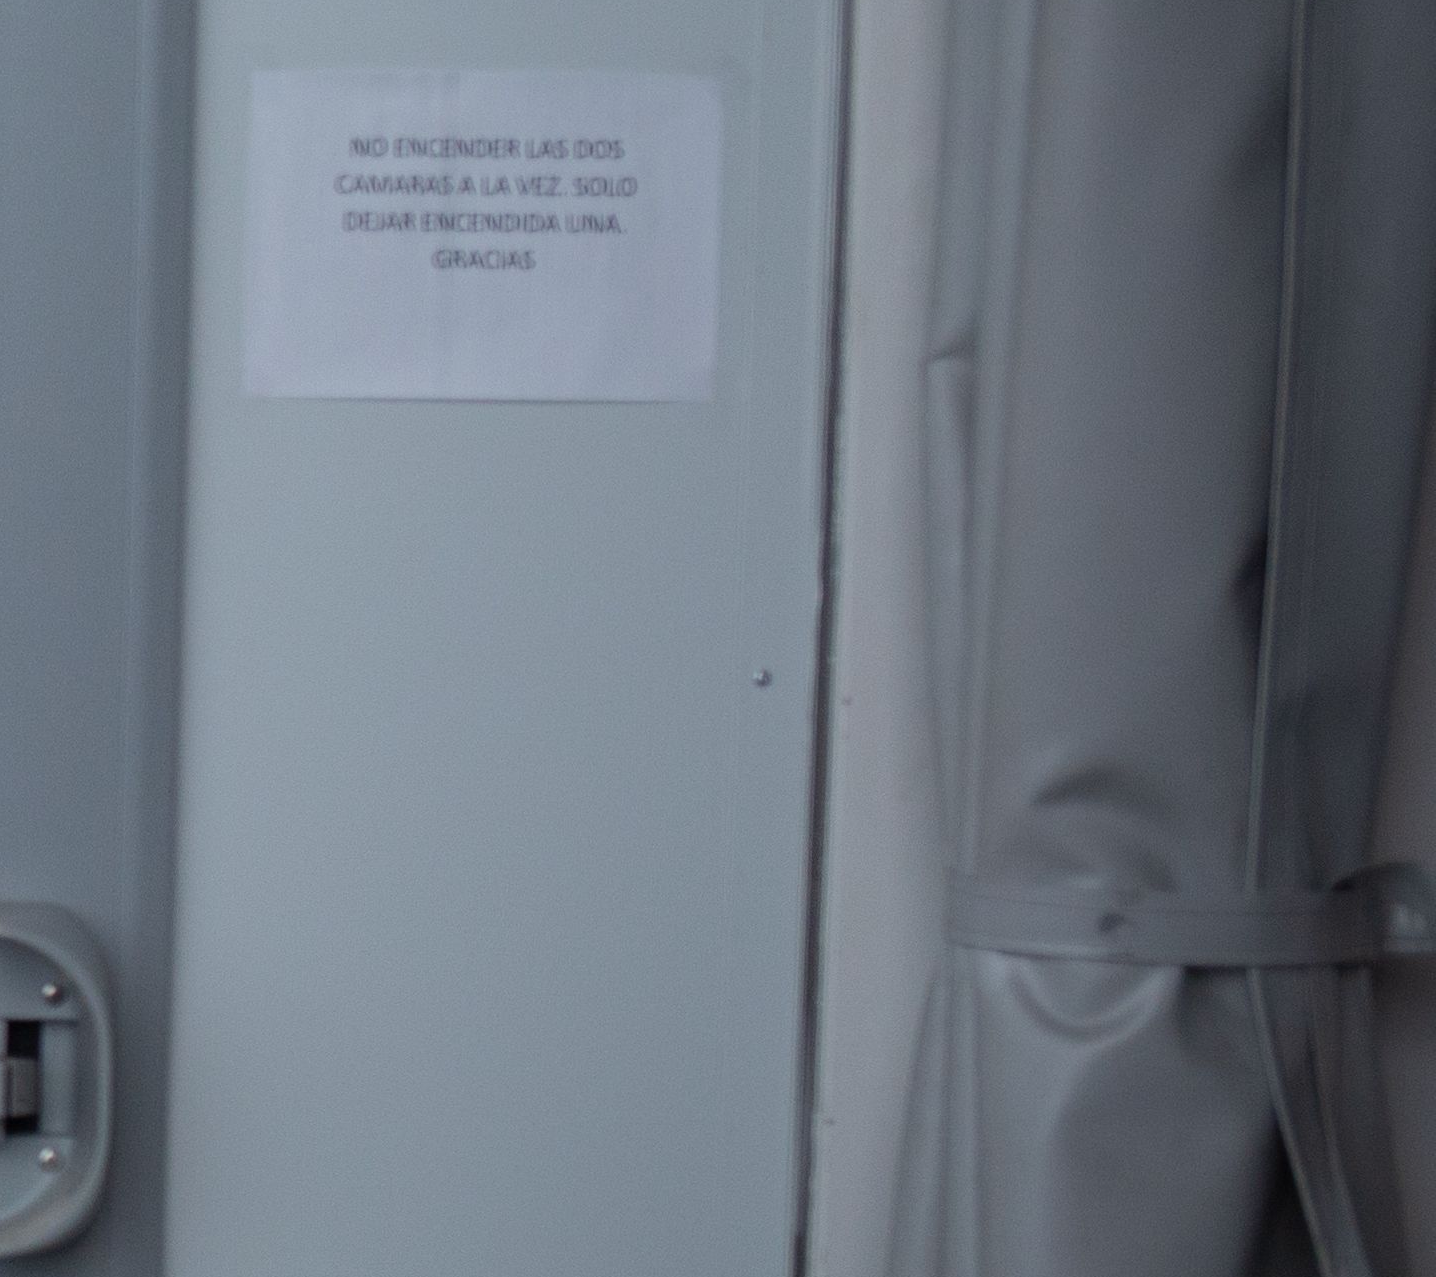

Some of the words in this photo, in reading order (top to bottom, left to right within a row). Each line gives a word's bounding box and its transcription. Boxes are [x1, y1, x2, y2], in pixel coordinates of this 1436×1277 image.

[349, 137, 390, 158] NO
[394, 137, 521, 159] ENCENDER
[525, 138, 568, 159] LAS
[573, 139, 625, 159] DOS
[334, 174, 454, 196] CAMARAS
[456, 176, 477, 196] A
[480, 176, 511, 196] LA
[573, 176, 638, 197] SOLO
[345, 211, 414, 232] DEJAR
[419, 211, 560, 233] ENCENDIDA
[431, 248, 536, 270] GRACIAS
